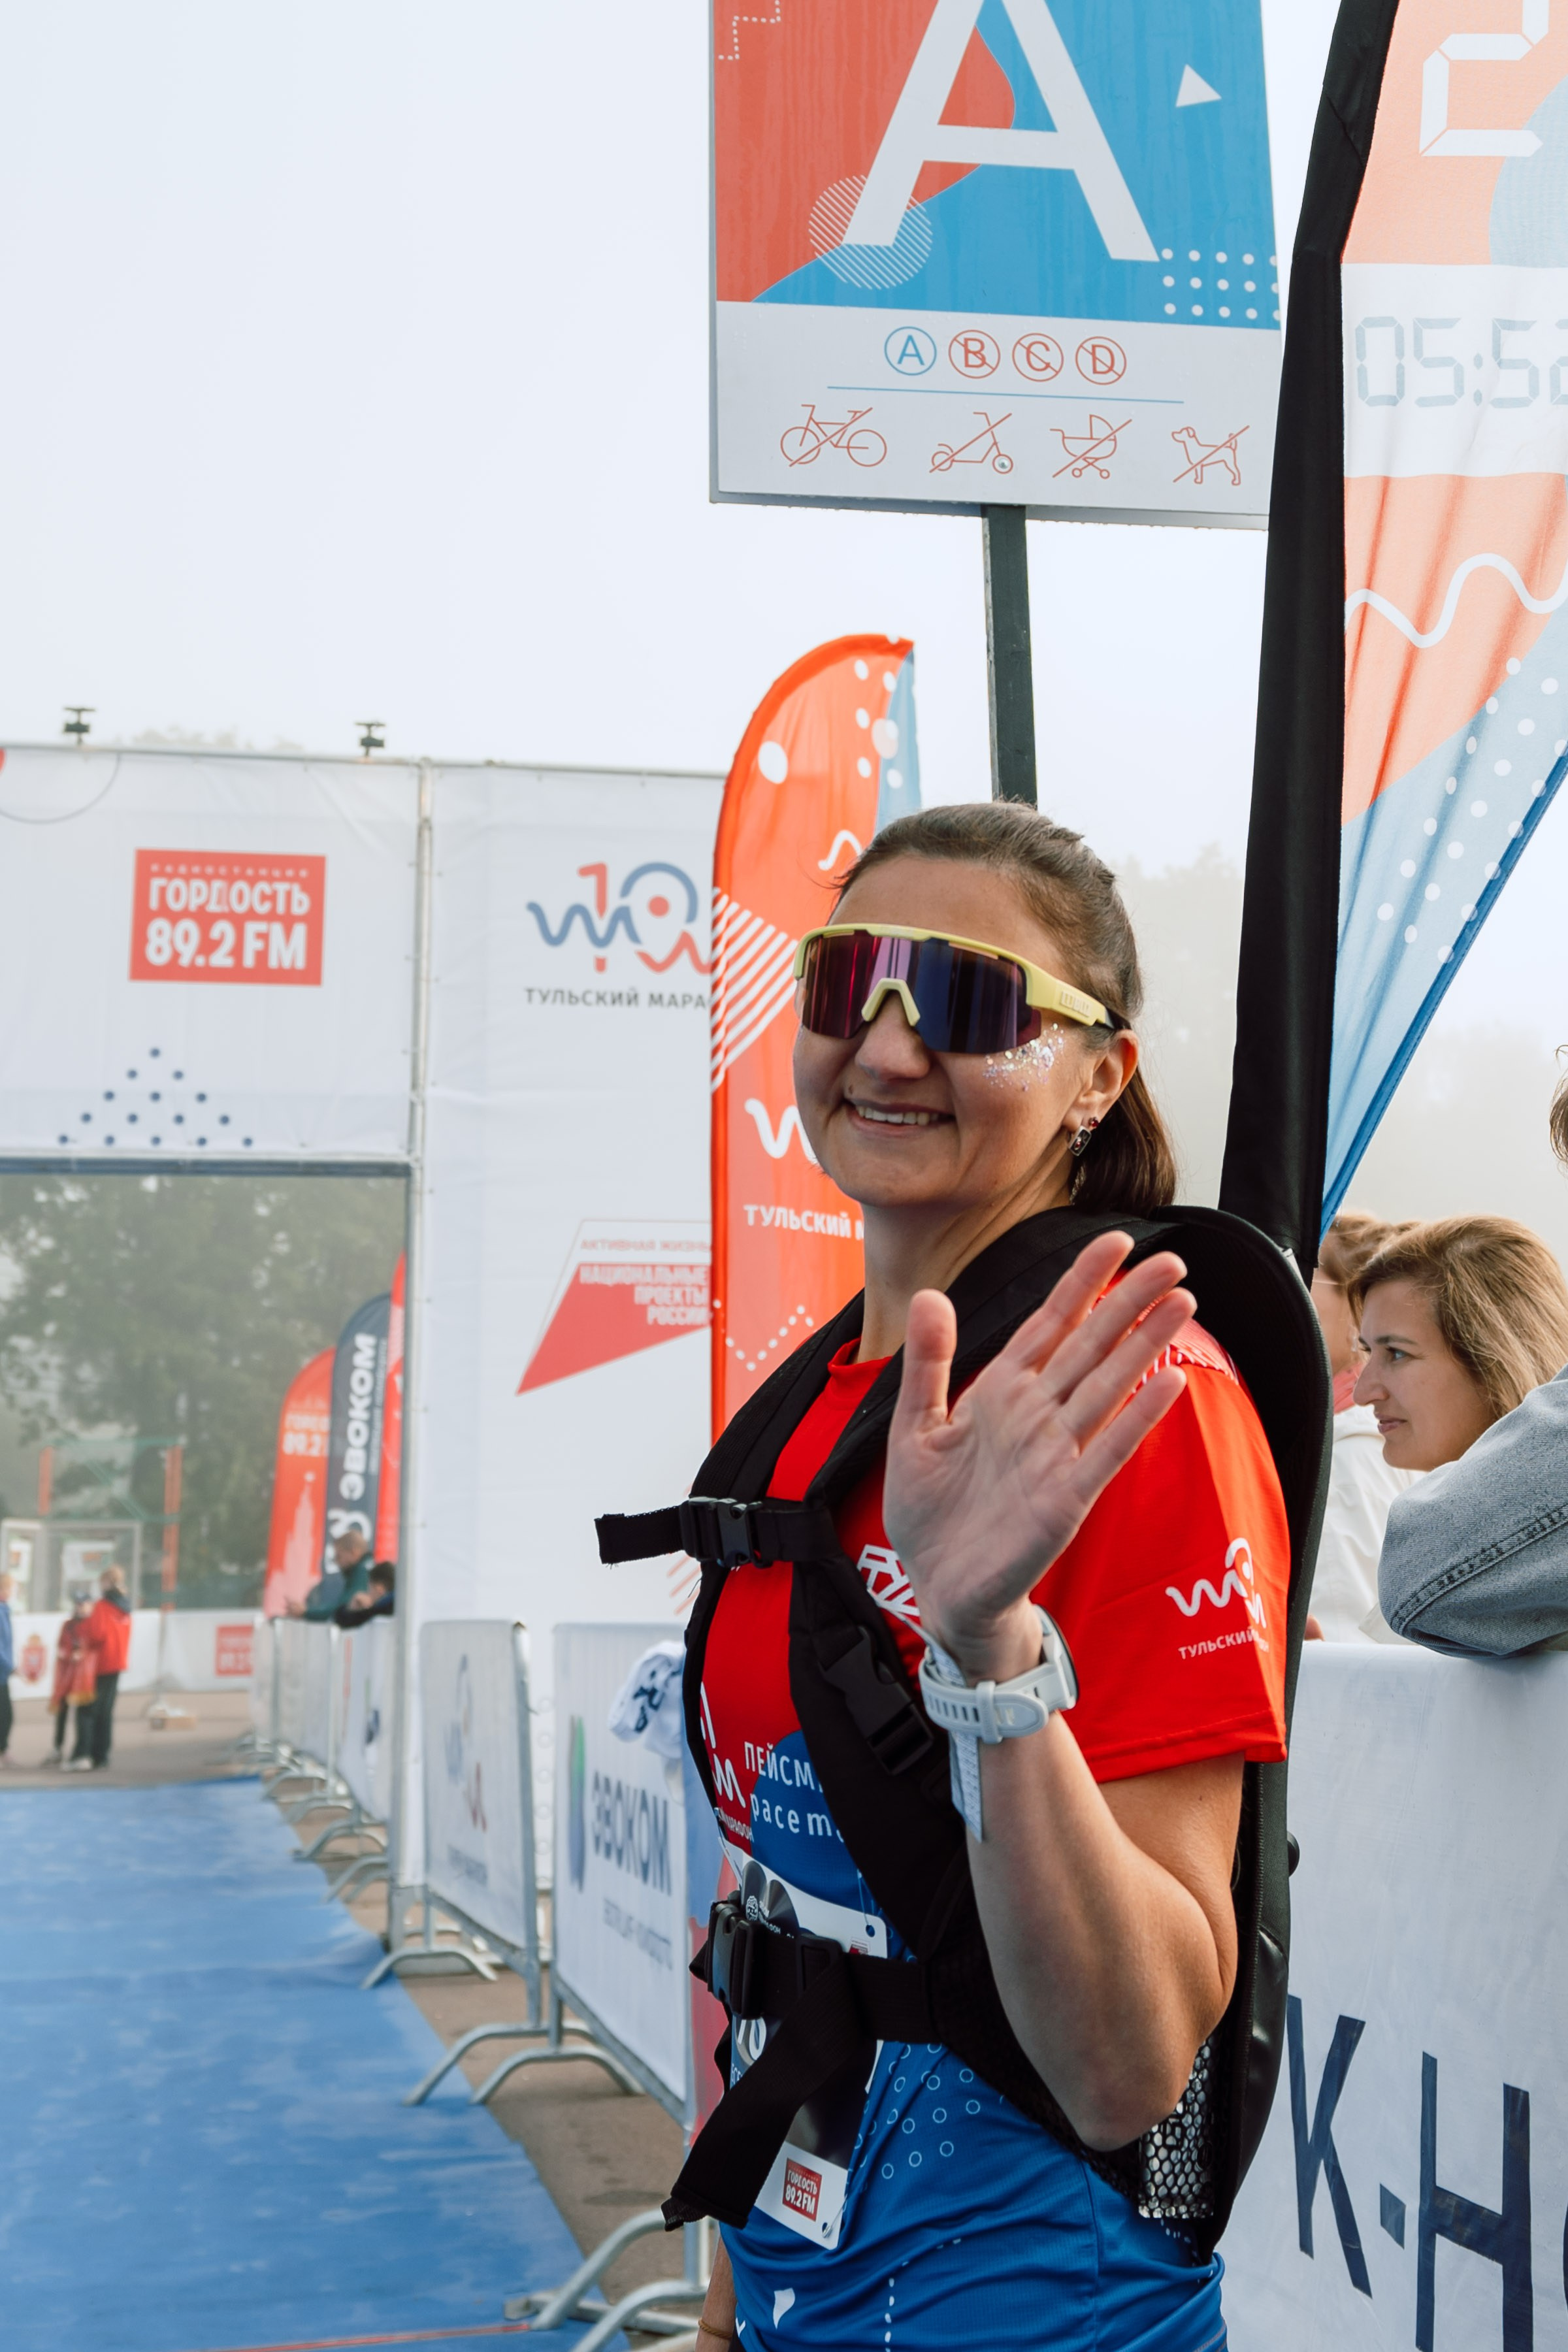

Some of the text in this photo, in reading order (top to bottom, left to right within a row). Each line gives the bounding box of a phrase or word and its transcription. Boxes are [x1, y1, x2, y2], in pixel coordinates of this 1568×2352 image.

[896, 335, 1116, 375] A B C D
[149, 877, 310, 915] ГОРДОСТЬ
[145, 917, 308, 970] 89.2 FM
[525, 985, 639, 1007] ТУЛЬСКИЙ
[743, 1204, 851, 1239] ТУЛЬСКИЙ
[338, 1332, 378, 1501] ЭВОКОМ
[1178, 1625, 1256, 1659] ТУЛЬСКИЙ
[744, 1741, 824, 1793] ПЕЙСМ
[750, 1793, 800, 1833] pace
[592, 1770, 672, 1896] ЭВОКОМ
[785, 2184, 816, 2214] 89.2 FM
[787, 2170, 817, 2195] ГОРДОСТЬ
